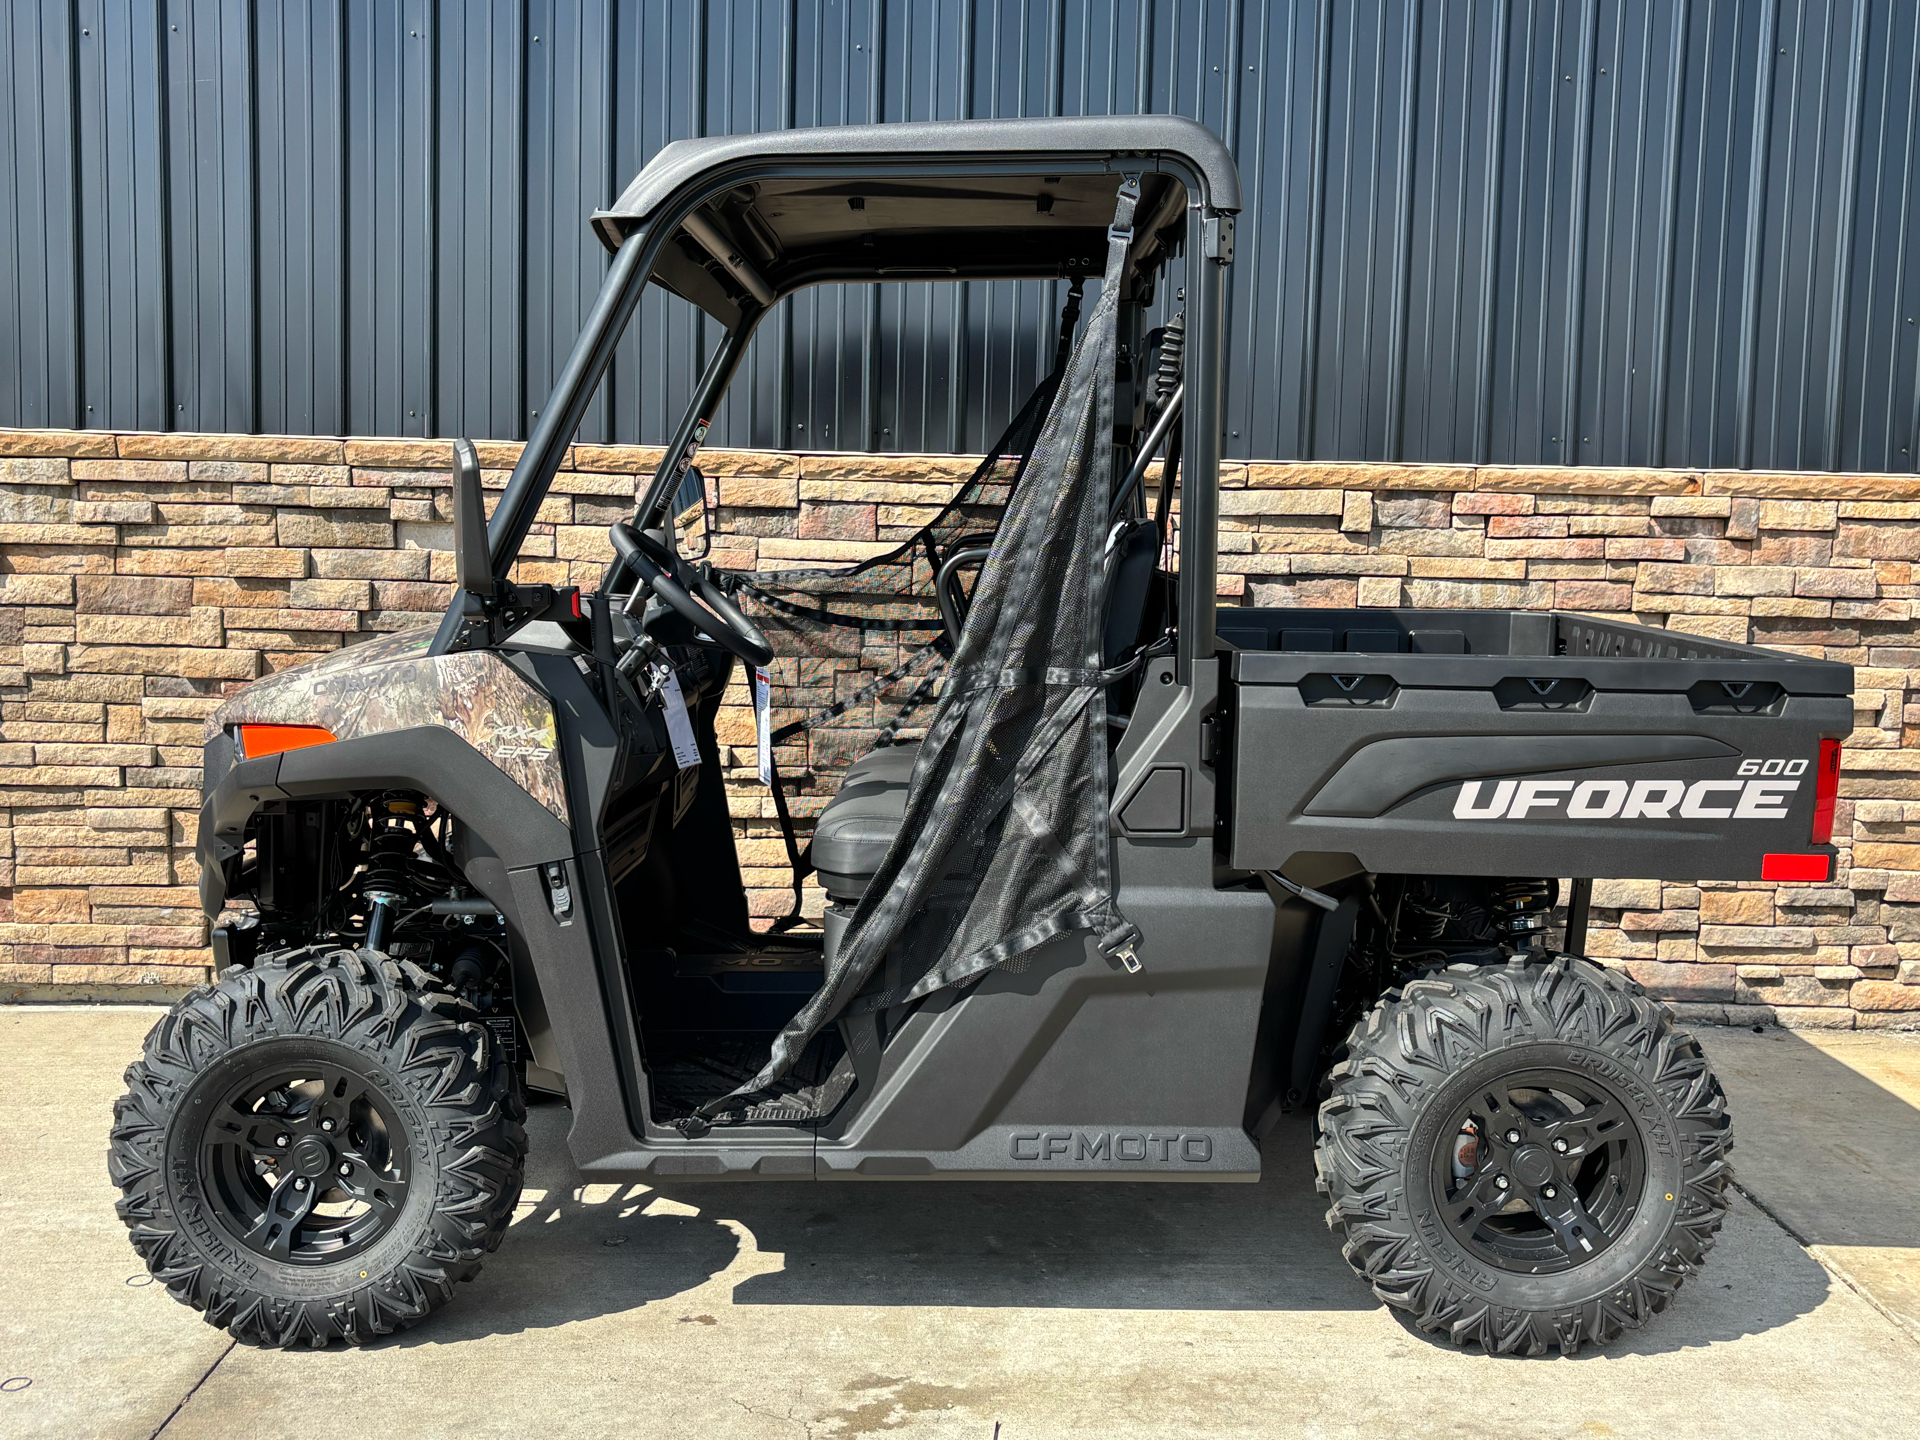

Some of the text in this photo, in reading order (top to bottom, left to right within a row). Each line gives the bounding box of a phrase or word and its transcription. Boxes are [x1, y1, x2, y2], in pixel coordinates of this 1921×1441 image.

[313, 664, 417, 695] CFMOTO
[1736, 758, 1810, 776] 600
[1452, 780, 1801, 819] UFORCE
[1567, 1050, 1654, 1114] BRUISER
[364, 1069, 432, 1168] ARISUN
[1009, 1132, 1213, 1162] CFMOTO
[1414, 1207, 1500, 1292] ARISUN
